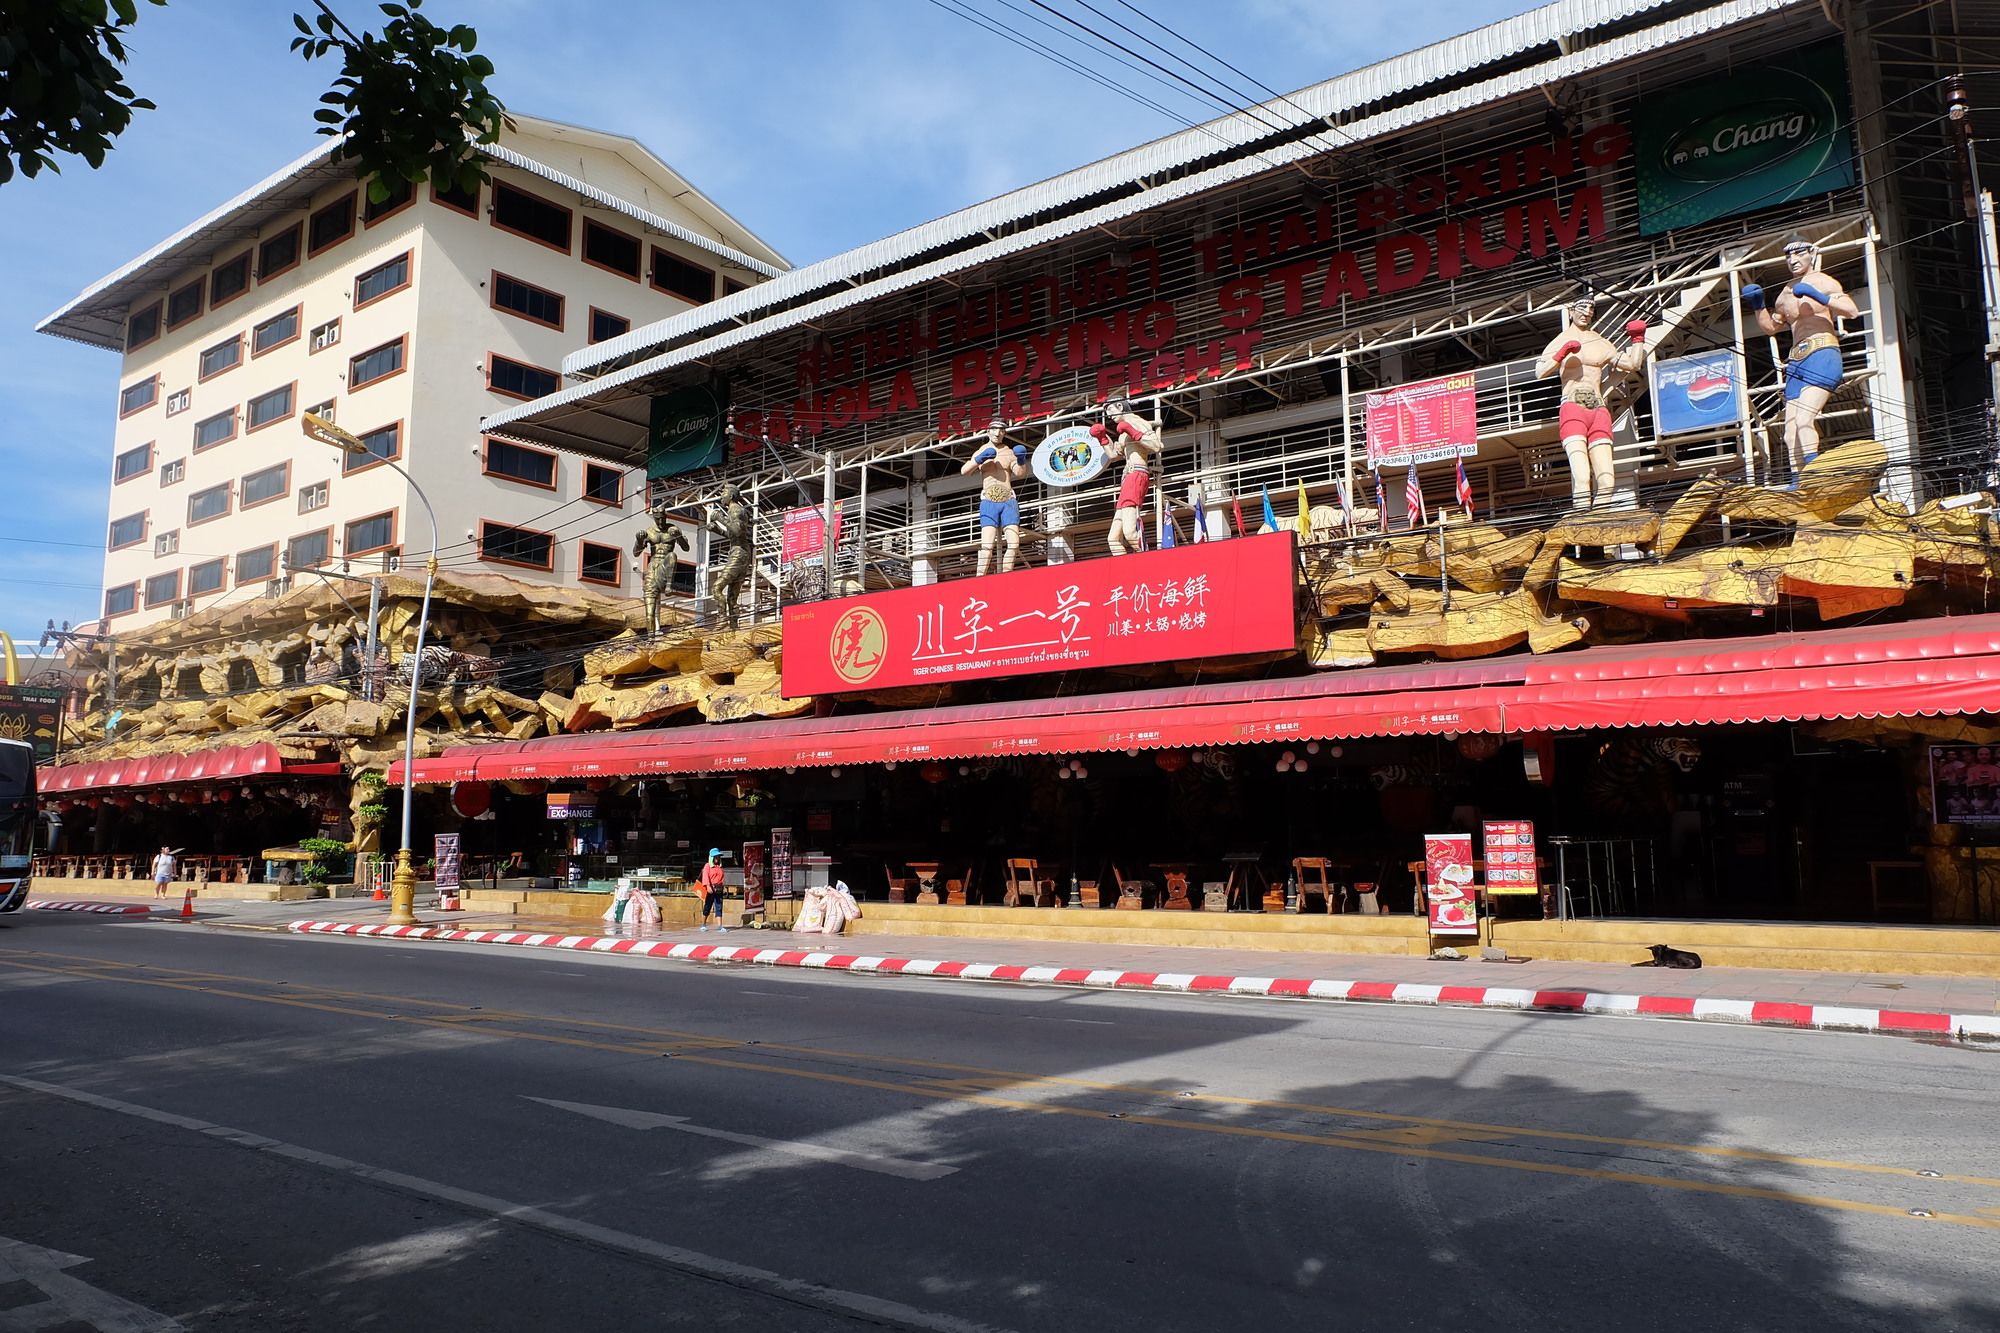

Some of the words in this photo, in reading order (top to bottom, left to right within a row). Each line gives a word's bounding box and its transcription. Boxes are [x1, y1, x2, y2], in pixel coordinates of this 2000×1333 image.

[1711, 113, 1804, 153] Chang
[1192, 204, 1332, 273] THAI
[1353, 123, 1633, 232] BOXING
[735, 371, 919, 456] BANGLA
[952, 301, 1179, 401] BOXING
[1219, 185, 1606, 330] STADIUM
[939, 383, 1055, 439] REAL
[1097, 328, 1264, 403] FIGHT
[1659, 360, 1732, 390] PEPSI
[677, 416, 709, 434] Chang
[1103, 574, 1211, 617] 平价海鲜
[911, 585, 1090, 655] 川字一号
[912, 667, 929, 677] TIGER
[929, 664, 955, 675] CHINESE
[955, 660, 992, 672] RESTAURANT
[22, 695, 37, 703] THAI
[1722, 781, 1743, 790] ATM
[551, 809, 593, 819] EXCHANGE
